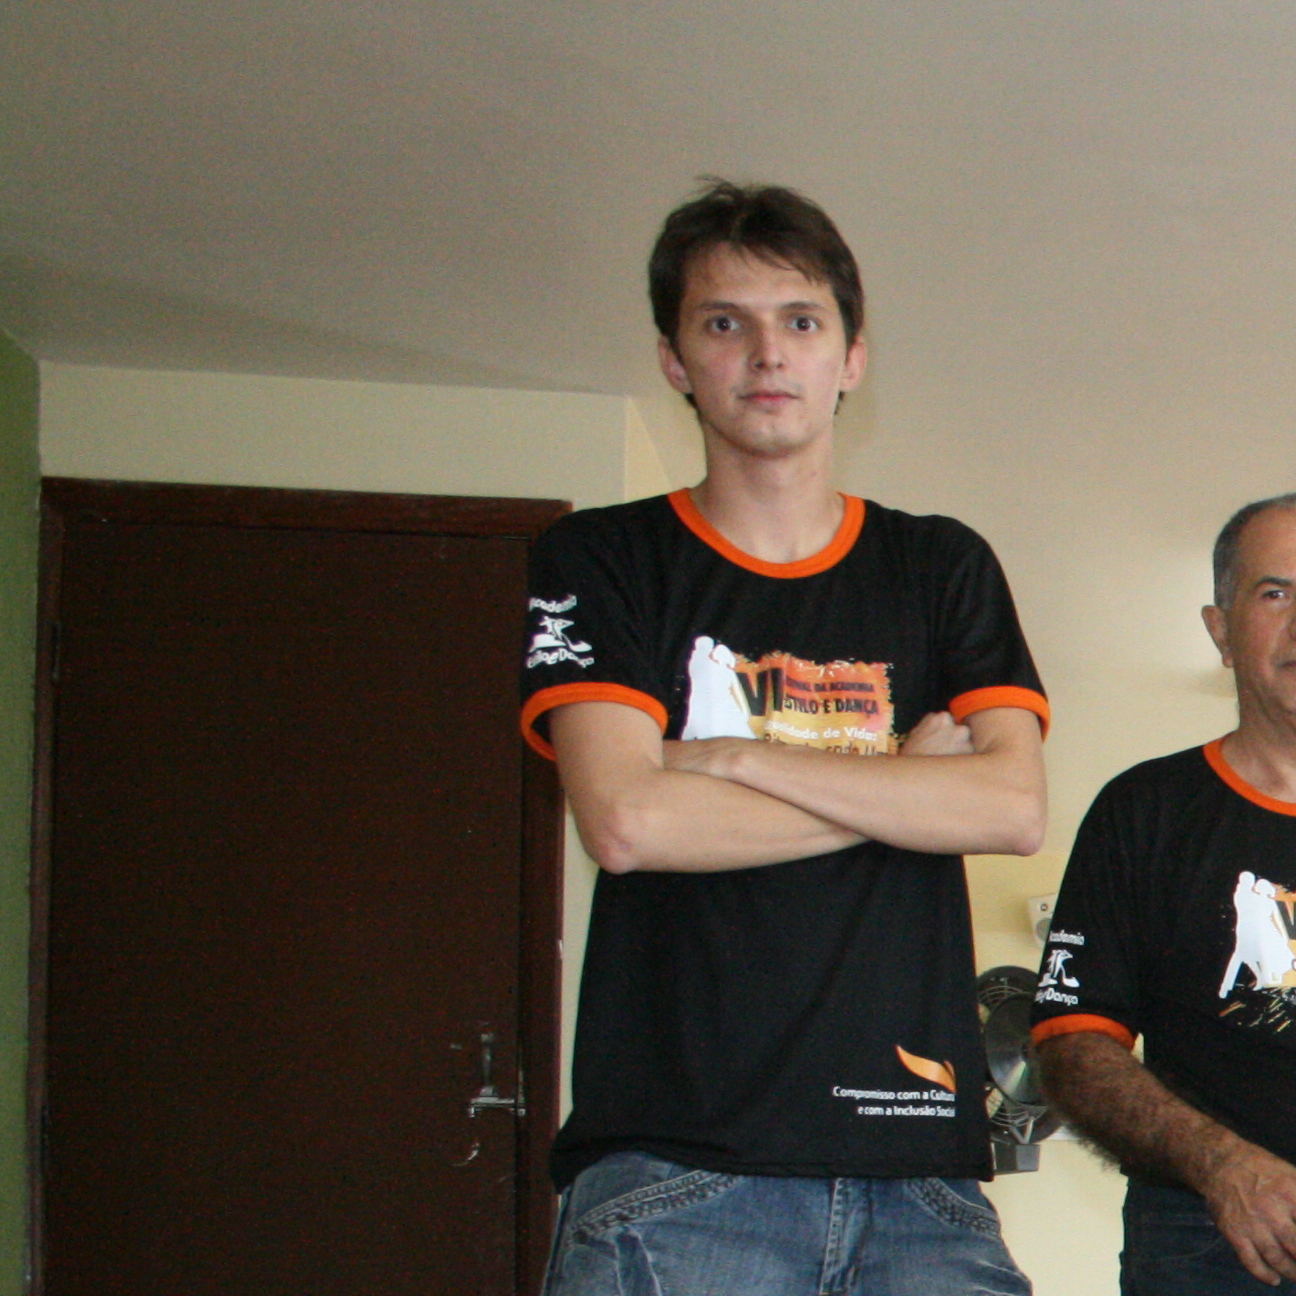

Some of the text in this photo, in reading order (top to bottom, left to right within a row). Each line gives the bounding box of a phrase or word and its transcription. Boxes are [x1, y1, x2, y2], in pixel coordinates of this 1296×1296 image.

[823, 700, 831, 714] E
[823, 727, 841, 739] de
[832, 1086, 896, 1100] Compromisso
[896, 1091, 921, 1100] com
[922, 1091, 929, 1100] a
[857, 1106, 864, 1115] e
[864, 1107, 884, 1116] com
[885, 1107, 892, 1116] a
[894, 1105, 936, 1116] Inclusão
